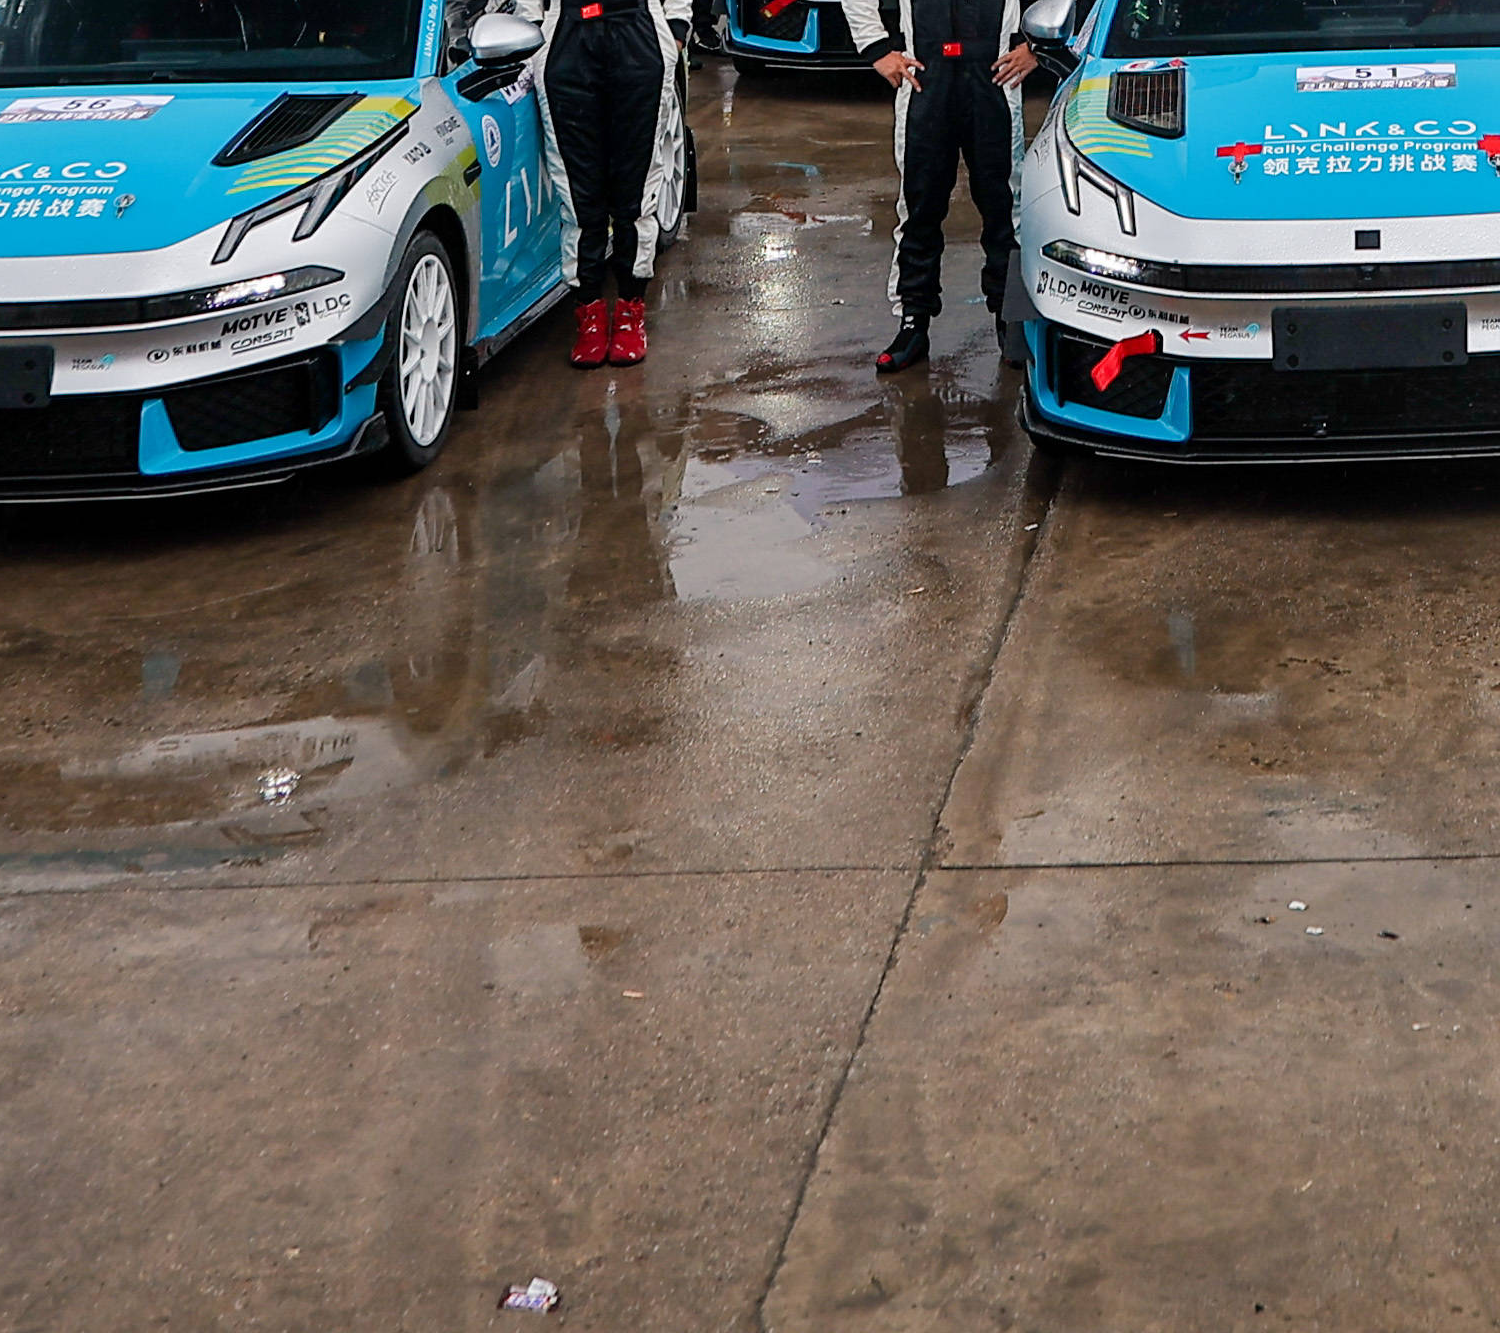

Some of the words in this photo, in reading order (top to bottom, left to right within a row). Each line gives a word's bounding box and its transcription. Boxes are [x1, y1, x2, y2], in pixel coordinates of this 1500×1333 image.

[1356, 67, 1398, 78] 51
[63, 99, 111, 110] 56
[1265, 121, 1477, 140] LYNK&CO
[1263, 143, 1303, 155] Rally
[1311, 141, 1398, 153] Challenge
[1404, 141, 1478, 152] Program
[1263, 154, 1478, 175] 领克拉力挑战赛
[40, 184, 114, 196] Program
[1048, 278, 1076, 298] LDC
[1080, 282, 1129, 305] MOTVE
[313, 293, 351, 315] LDC
[221, 308, 288, 336] MOTVE
